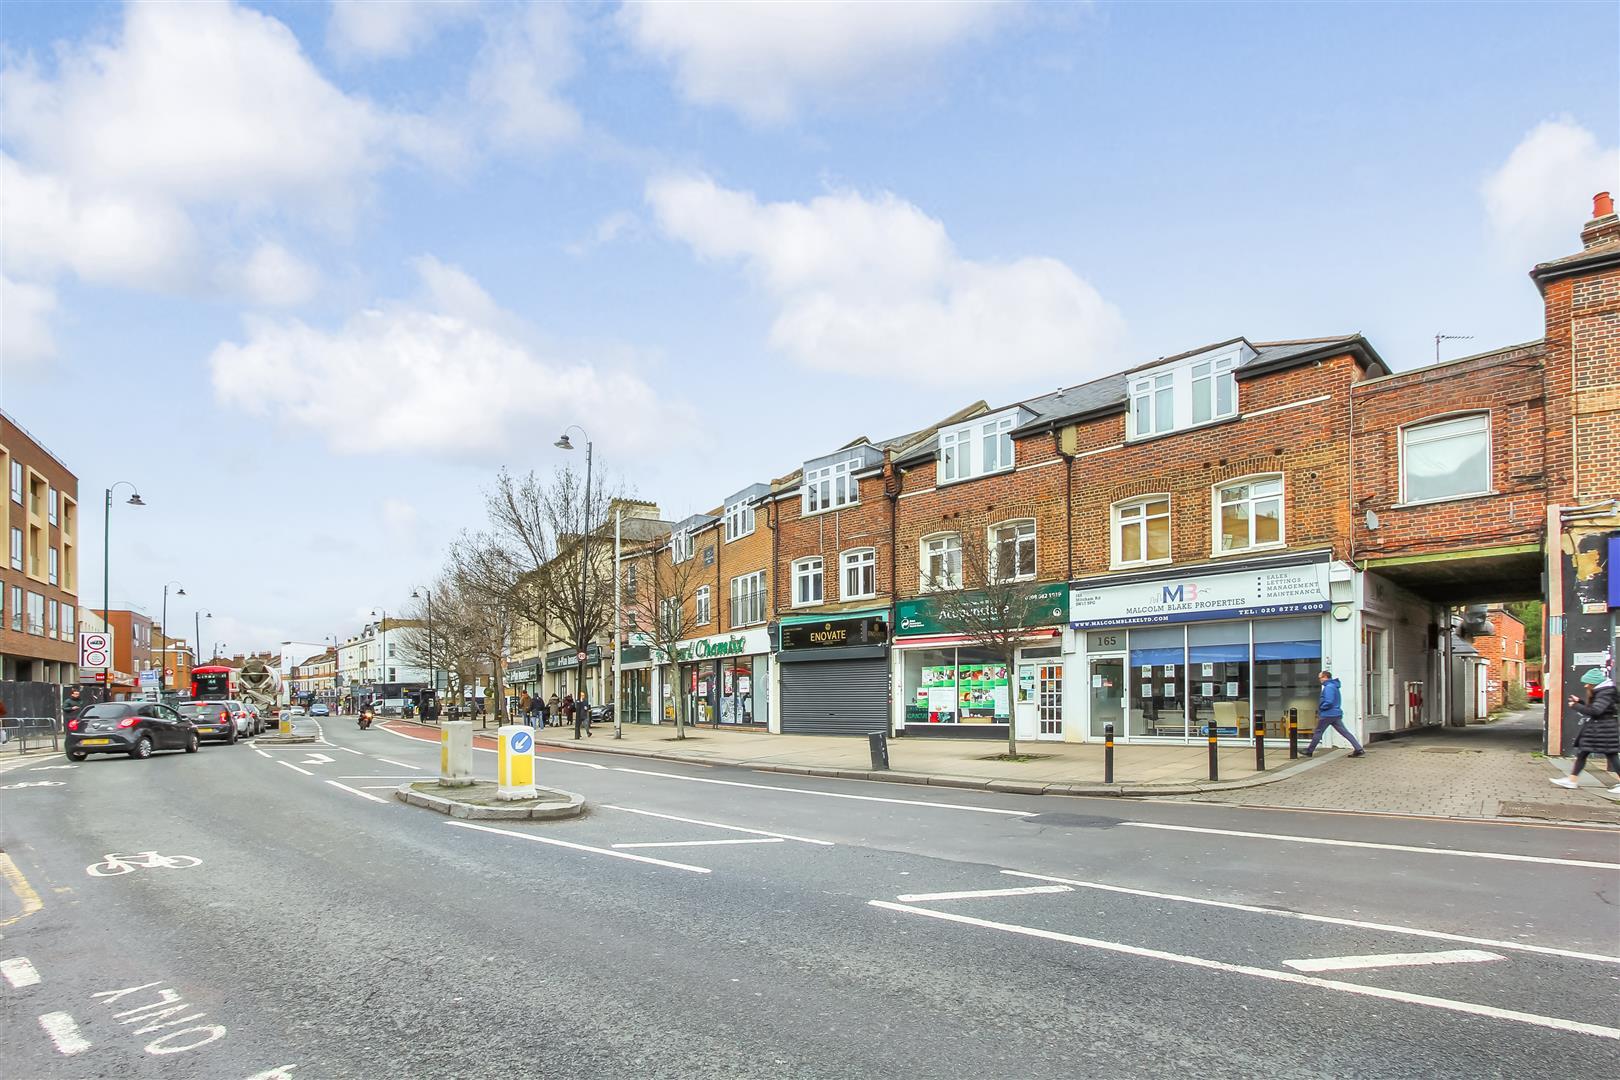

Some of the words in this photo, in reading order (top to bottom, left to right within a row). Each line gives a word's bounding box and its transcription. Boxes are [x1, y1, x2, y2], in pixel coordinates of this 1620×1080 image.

[1266, 582, 1319, 591] MANAGEMENT
[1266, 588, 1321, 598] MAINTENANCE
[1162, 583, 1198, 604] MB
[938, 604, 1010, 621] Acupunctue
[1126, 605, 1165, 615] MALCOLM
[1167, 602, 1192, 611] BLAKE
[1194, 598, 1246, 609] PROPERTIES
[1074, 616, 1168, 627] WWW.MALCOLMBLAKELTD.COM
[810, 629, 847, 642] ENOVATE
[1097, 636, 1117, 646] 165
[87, 981, 226, 1055] ONLY
